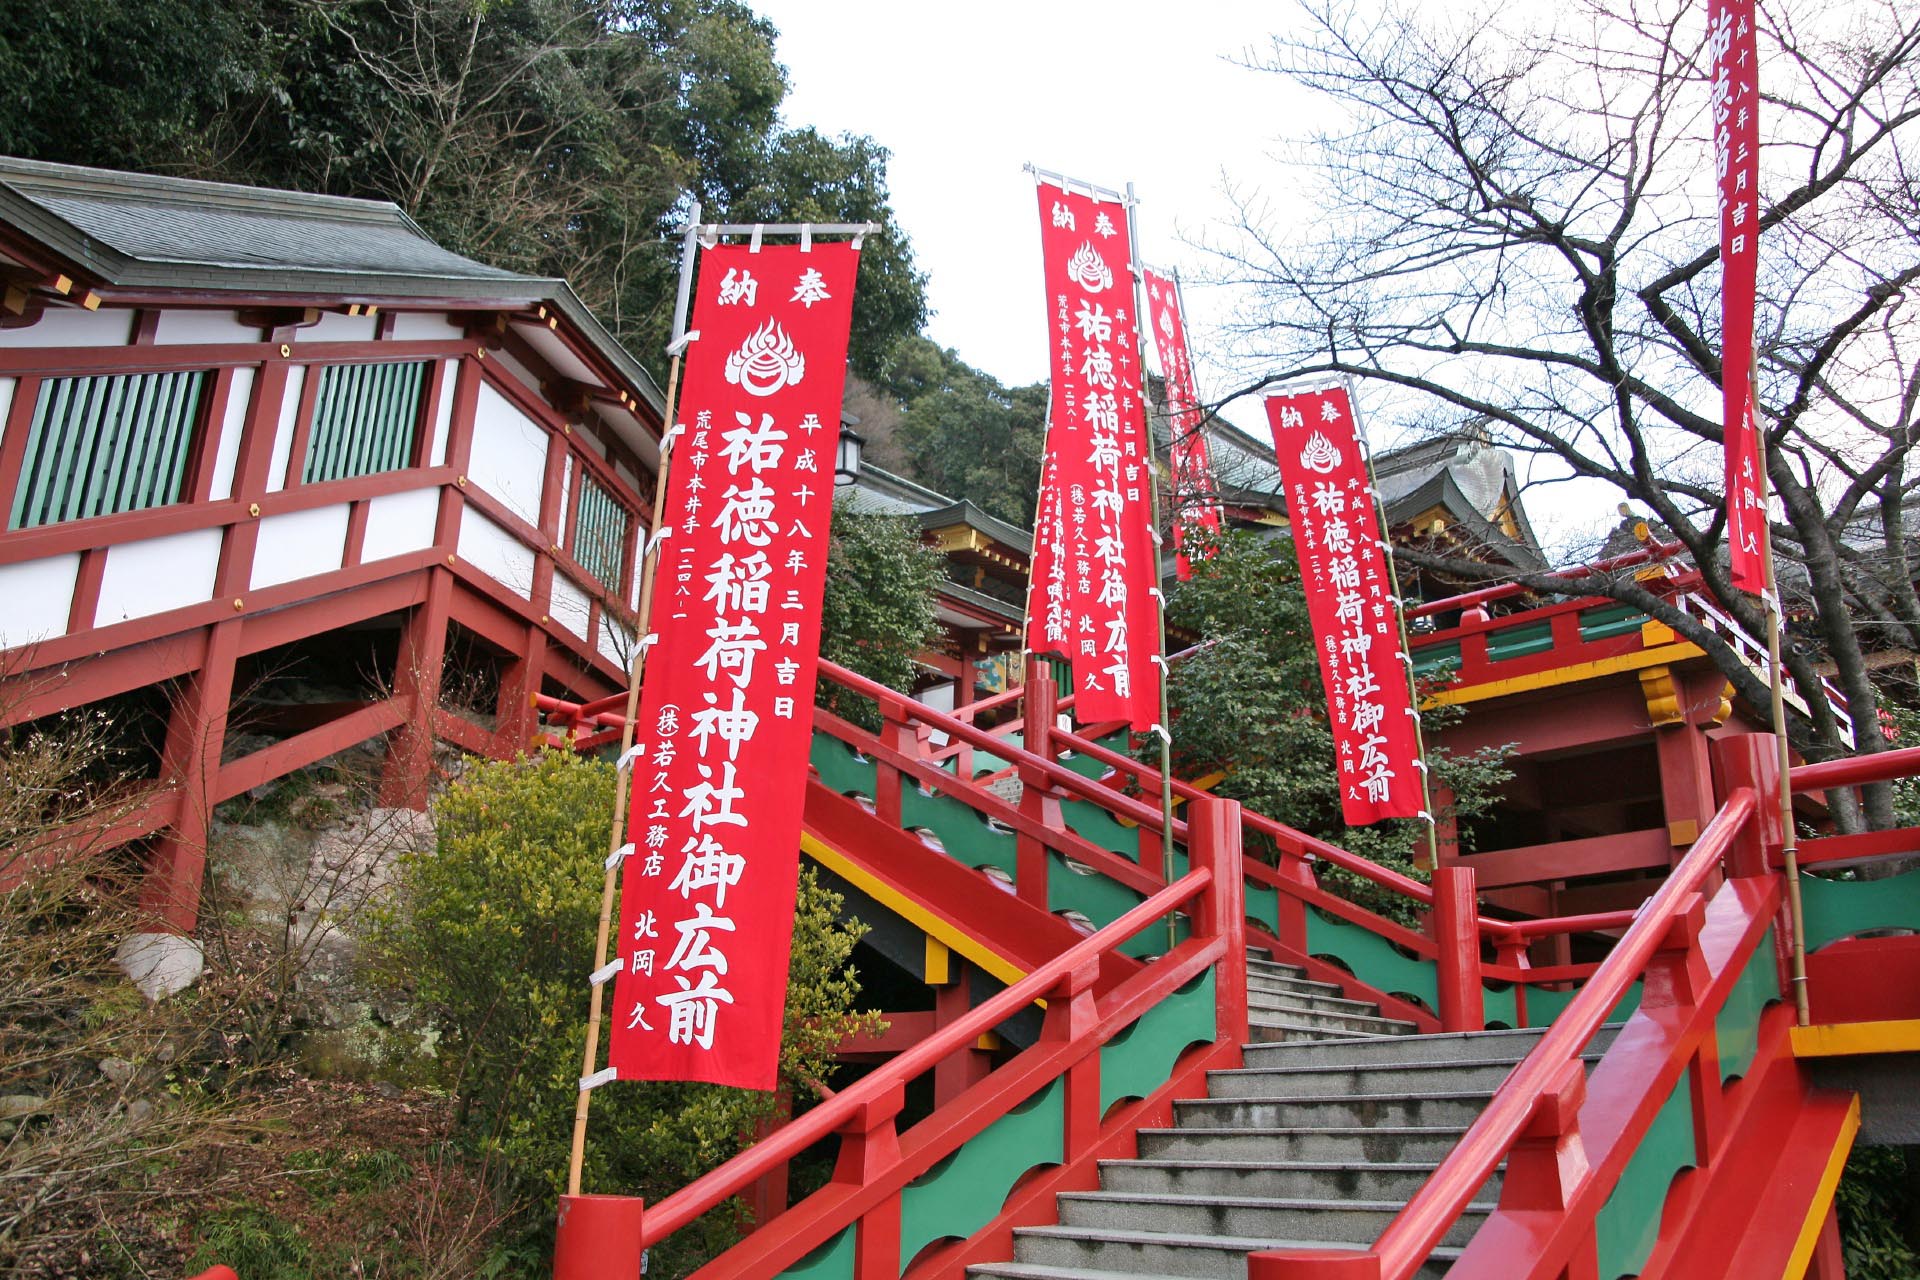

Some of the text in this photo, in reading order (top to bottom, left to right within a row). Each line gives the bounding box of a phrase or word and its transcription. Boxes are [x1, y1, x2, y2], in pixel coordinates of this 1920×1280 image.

[1731, 0, 1750, 255] 成十八年三月吉日
[1115, 308, 1140, 502] 平成十八年三月吉日
[773, 413, 823, 720] 平成十八年三月吉日
[1311, 480, 1396, 804] 祐徳稲荷神社御広前
[1347, 477, 1388, 634] 平成十八年三月吉日
[655, 410, 789, 1051] 祐徳稲荷神社御広前
